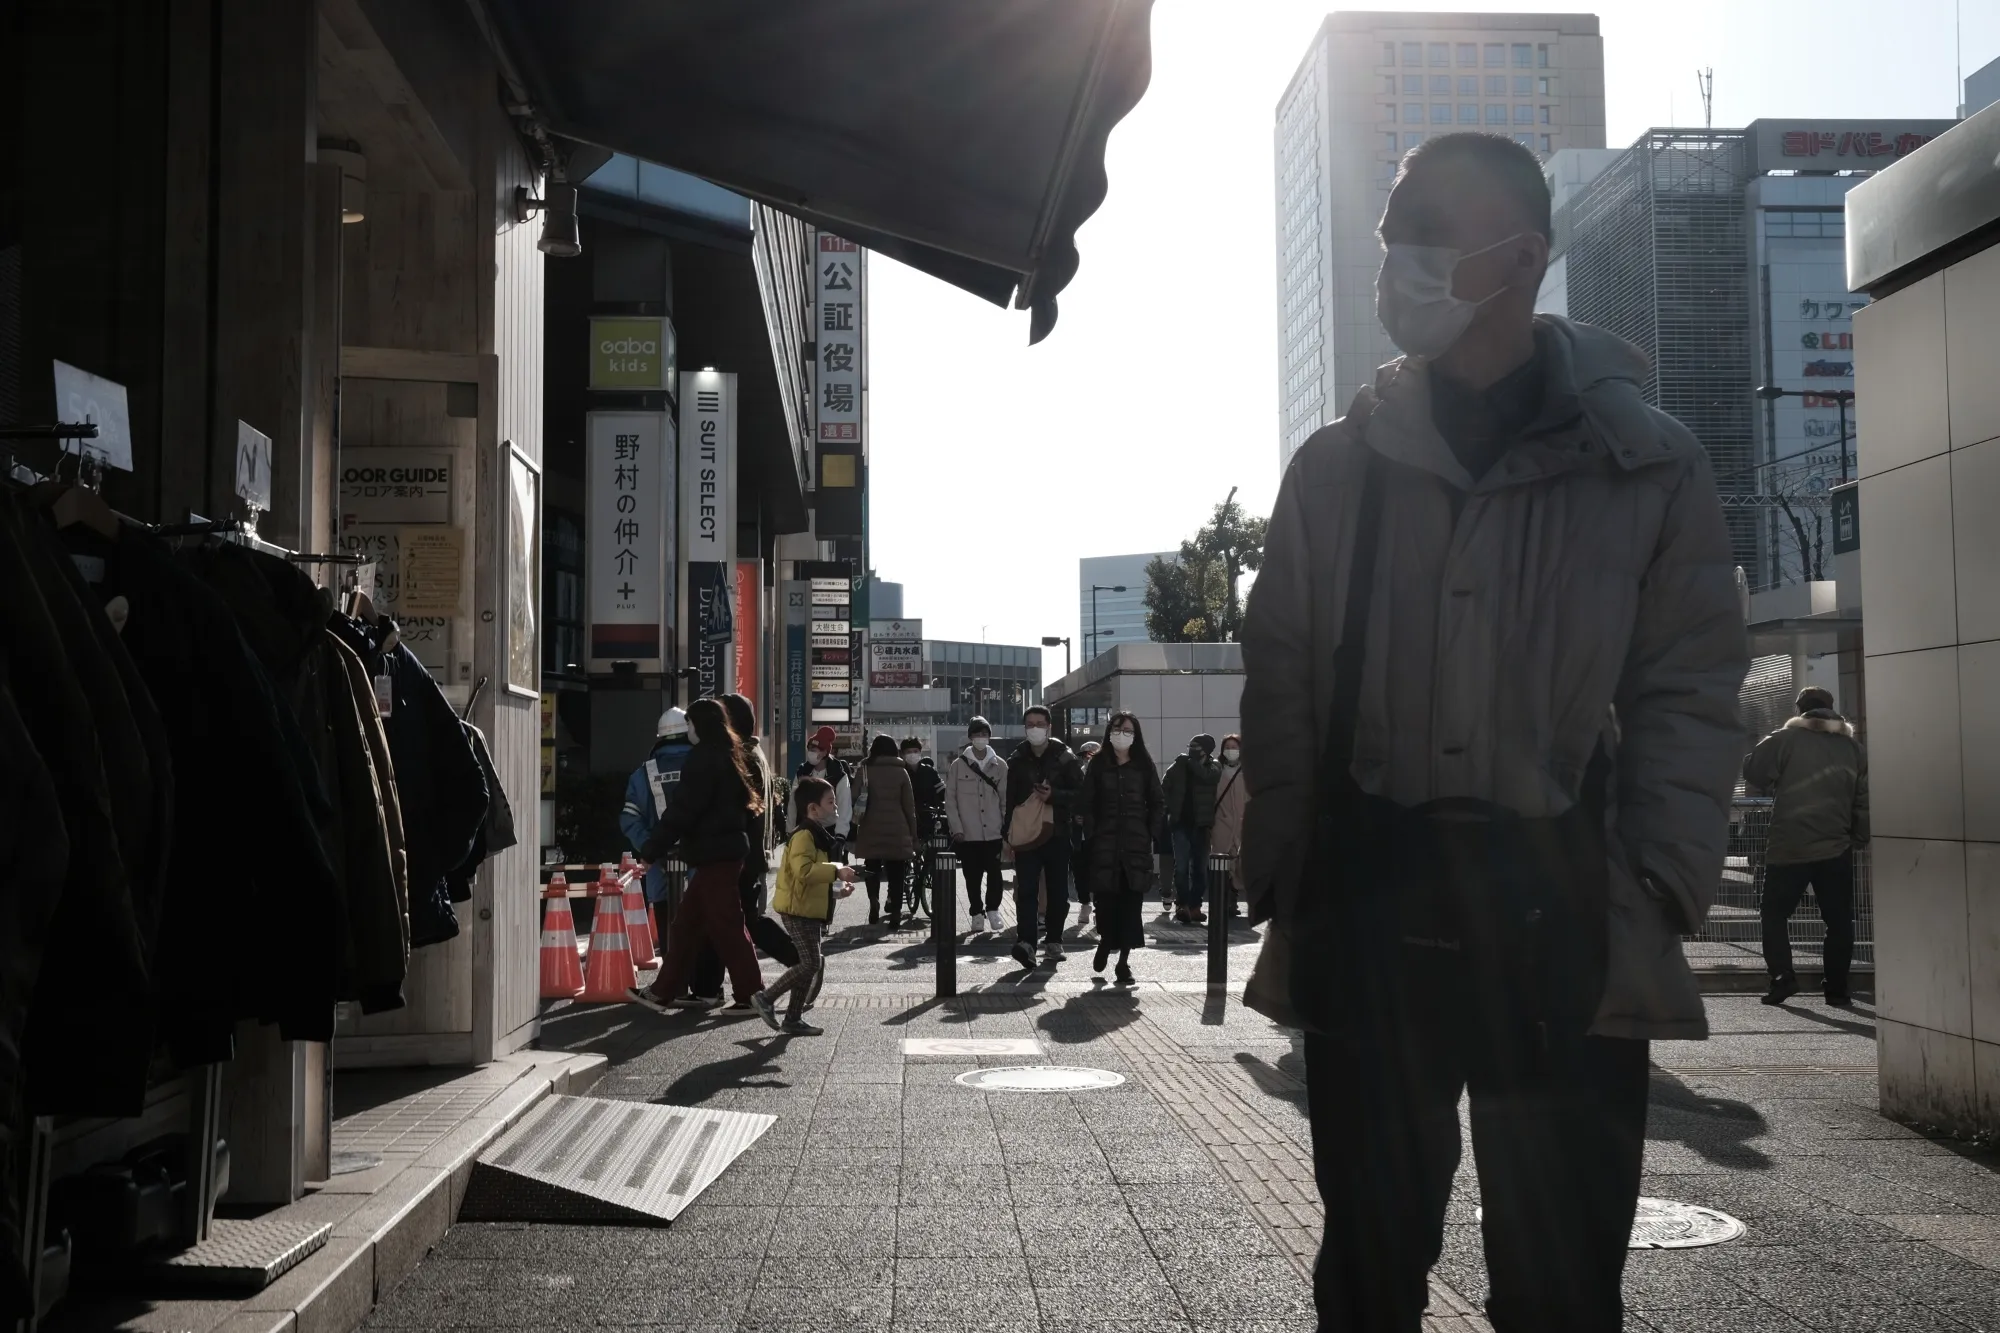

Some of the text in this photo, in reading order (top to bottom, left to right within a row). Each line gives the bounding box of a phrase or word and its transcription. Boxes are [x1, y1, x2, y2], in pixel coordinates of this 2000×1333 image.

[1784, 131, 1933, 156] ヨドバシカ
[823, 262, 854, 412] 公証役場
[1822, 332, 1854, 349] LI
[609, 358, 648, 372] kids
[824, 424, 854, 438] 遺言
[390, 468, 447, 483] GUIDE
[700, 419, 716, 542] SUIT SELECT
[350, 486, 424, 498] フロア案内
[815, 623, 845, 631] 大樹生命
[790, 650, 804, 743] 三井住友信託銀行
